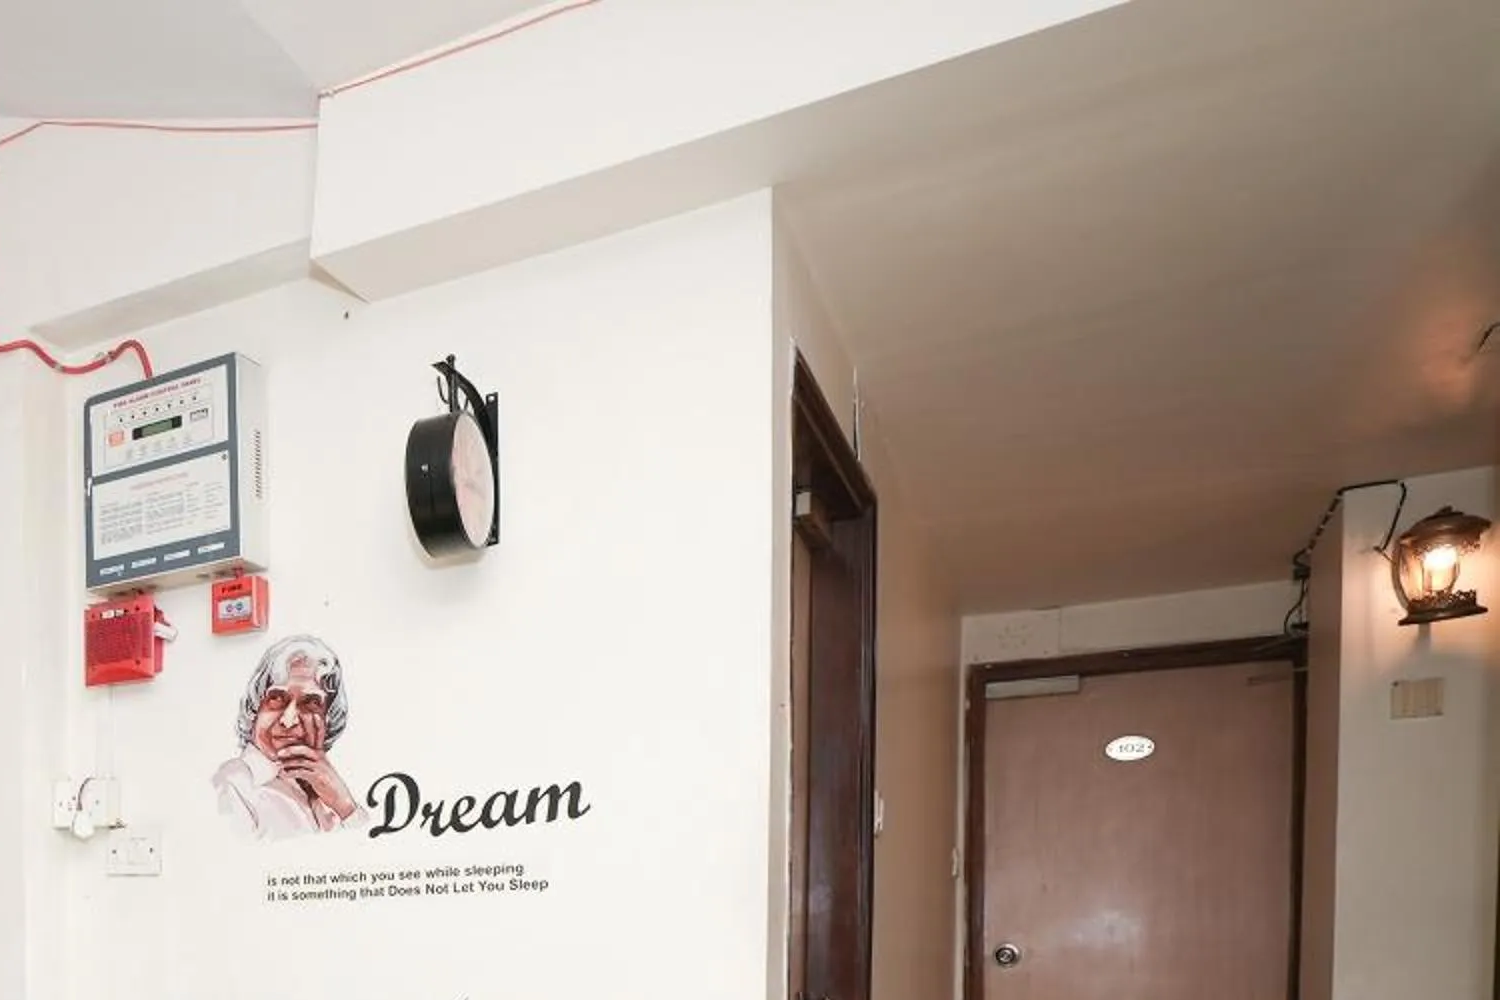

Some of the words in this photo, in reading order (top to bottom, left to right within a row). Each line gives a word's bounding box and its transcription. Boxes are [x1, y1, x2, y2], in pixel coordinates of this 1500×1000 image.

[366, 772, 591, 838] Dream
[267, 873, 277, 886] is
[281, 875, 300, 886] not
[303, 872, 327, 885] that
[329, 871, 367, 884] which
[371, 872, 395, 885] you
[398, 869, 420, 881] see
[425, 866, 460, 879] while
[464, 864, 524, 877] sleeping
[267, 889, 275, 901] it
[278, 889, 288, 901] is
[291, 888, 357, 901] something
[359, 885, 385, 898] that
[387, 884, 420, 897] Does
[425, 883, 449, 895] Not
[453, 881, 474, 893] Let
[478, 879, 505, 892] You
[509, 878, 549, 892] Sleep
